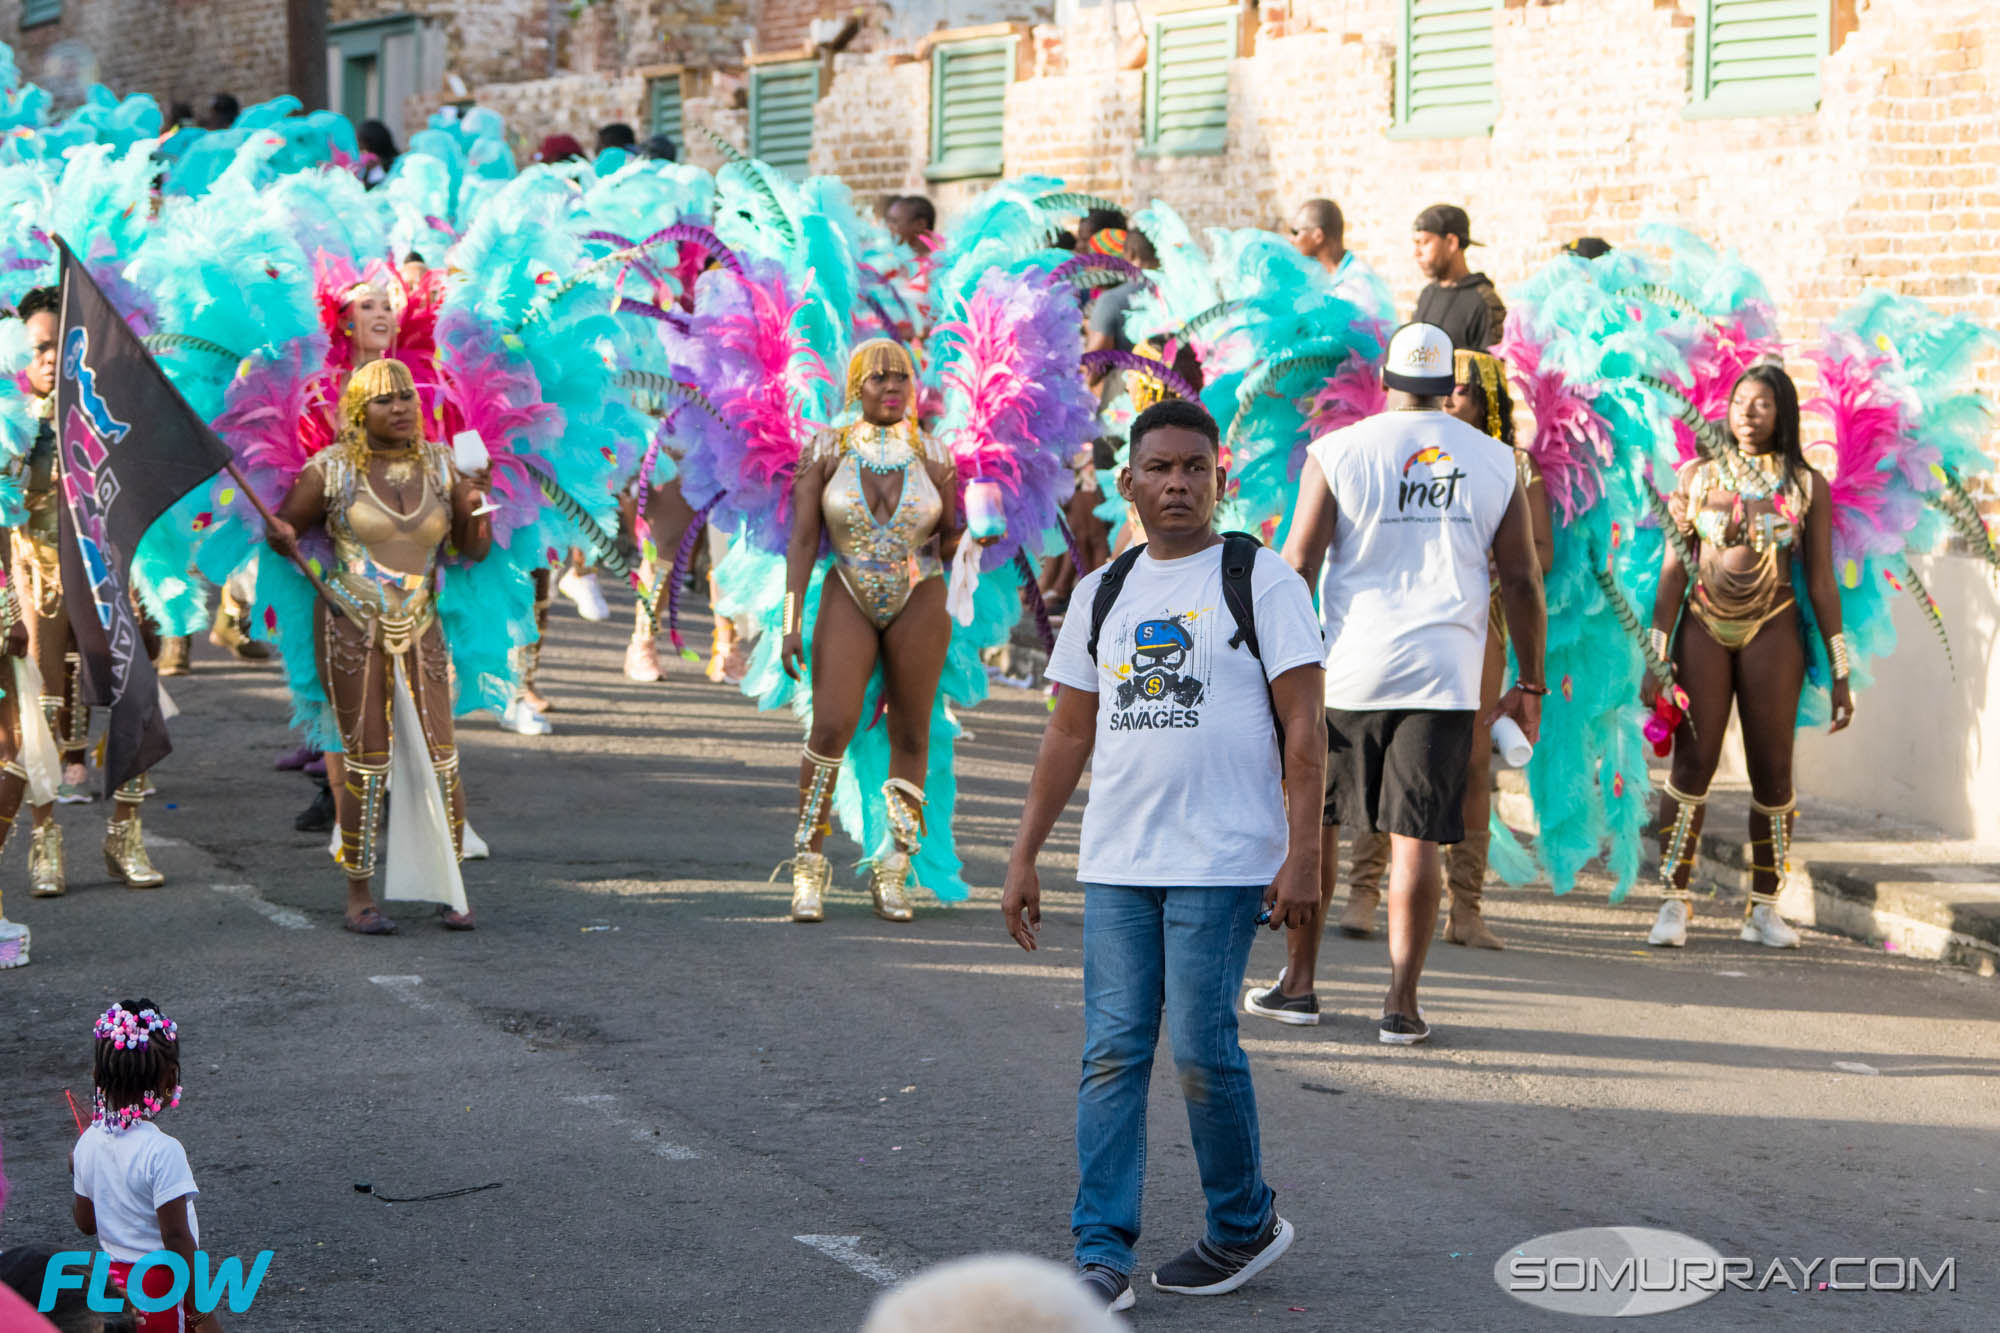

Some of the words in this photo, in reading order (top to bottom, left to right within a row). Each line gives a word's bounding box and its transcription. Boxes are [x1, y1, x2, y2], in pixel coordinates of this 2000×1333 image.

[1143, 626, 1154, 639] S
[1147, 677, 1161, 695] S
[1110, 710, 1200, 731] SAVAGES
